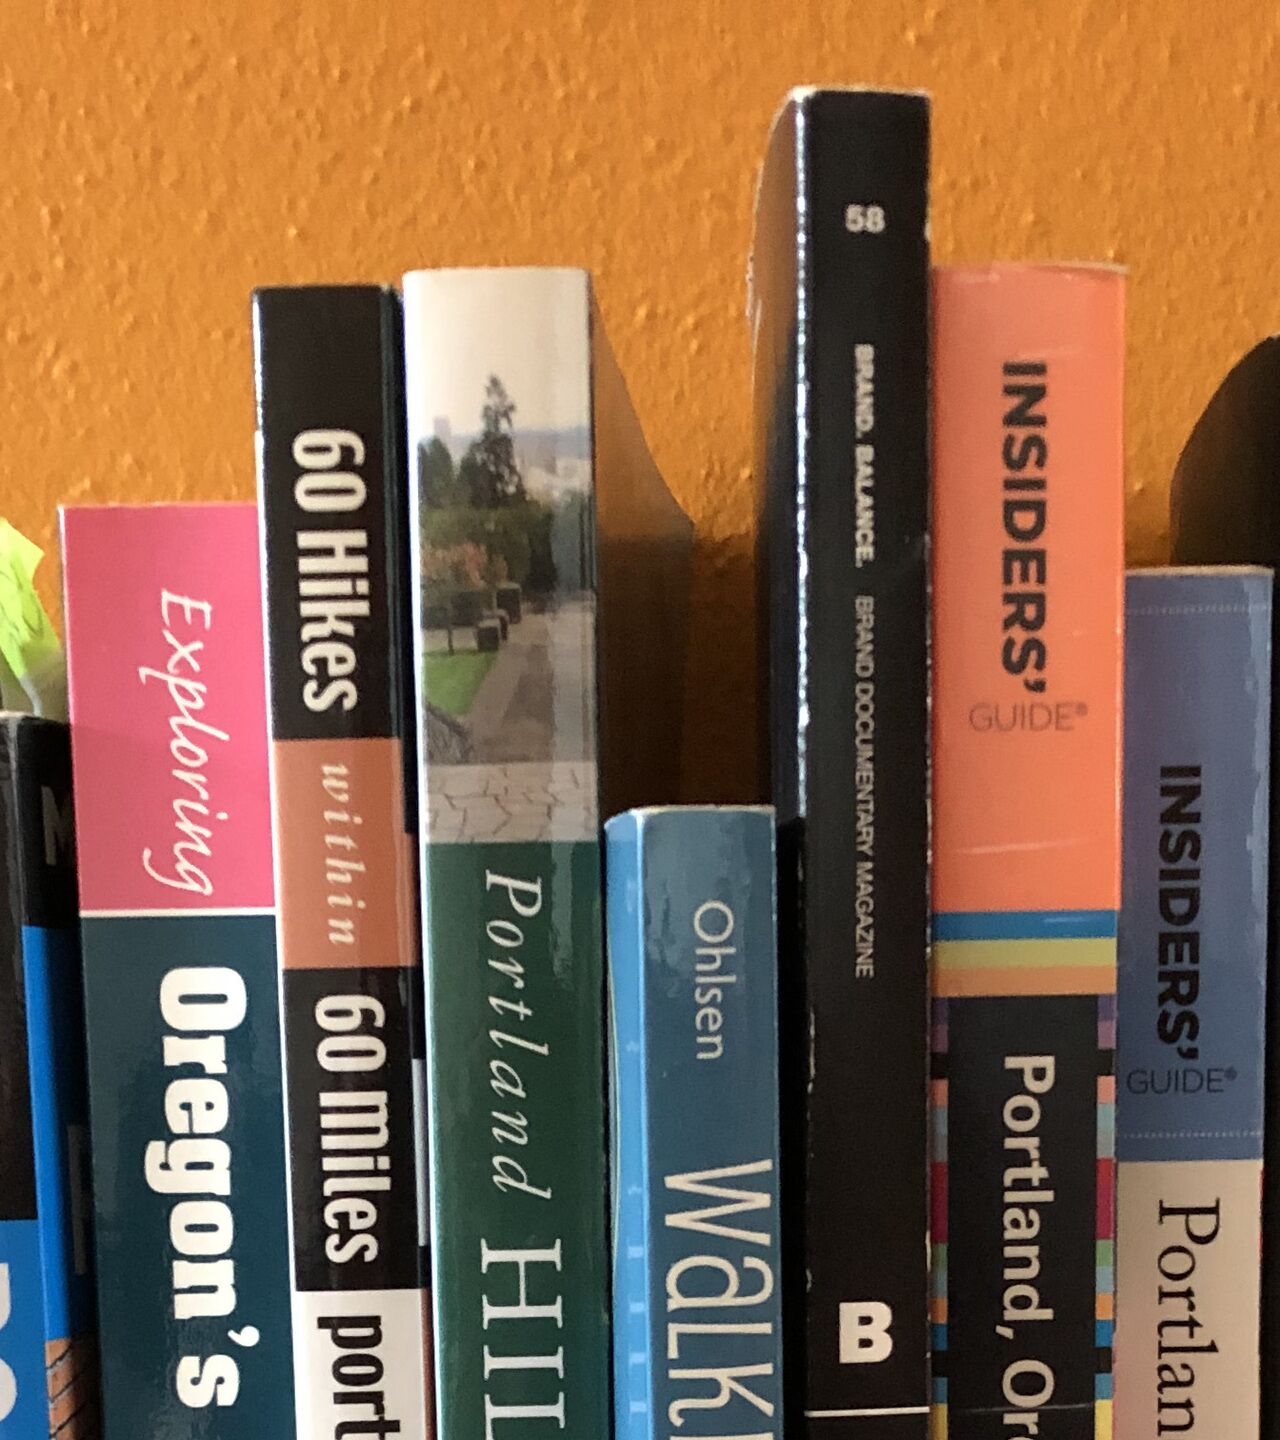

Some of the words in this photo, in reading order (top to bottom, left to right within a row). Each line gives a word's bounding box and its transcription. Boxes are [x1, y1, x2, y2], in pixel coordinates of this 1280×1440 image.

[292, 428, 367, 513] 60
[296, 528, 370, 713] Hikes
[854, 595, 875, 678] BRAND
[139, 588, 230, 896] Exploring
[854, 682, 875, 853] DOCUMENTARY
[322, 763, 366, 945] within
[854, 861, 875, 978] MAGAZINE
[315, 994, 386, 1072] 60
[485, 869, 552, 1200] Portland
[694, 901, 736, 1060] Ohlsen
[144, 966, 260, 1409] Oregon's
[318, 1091, 392, 1265] miles
[995, 1056, 1055, 1339] Portland,
[838, 1301, 894, 1364] B
